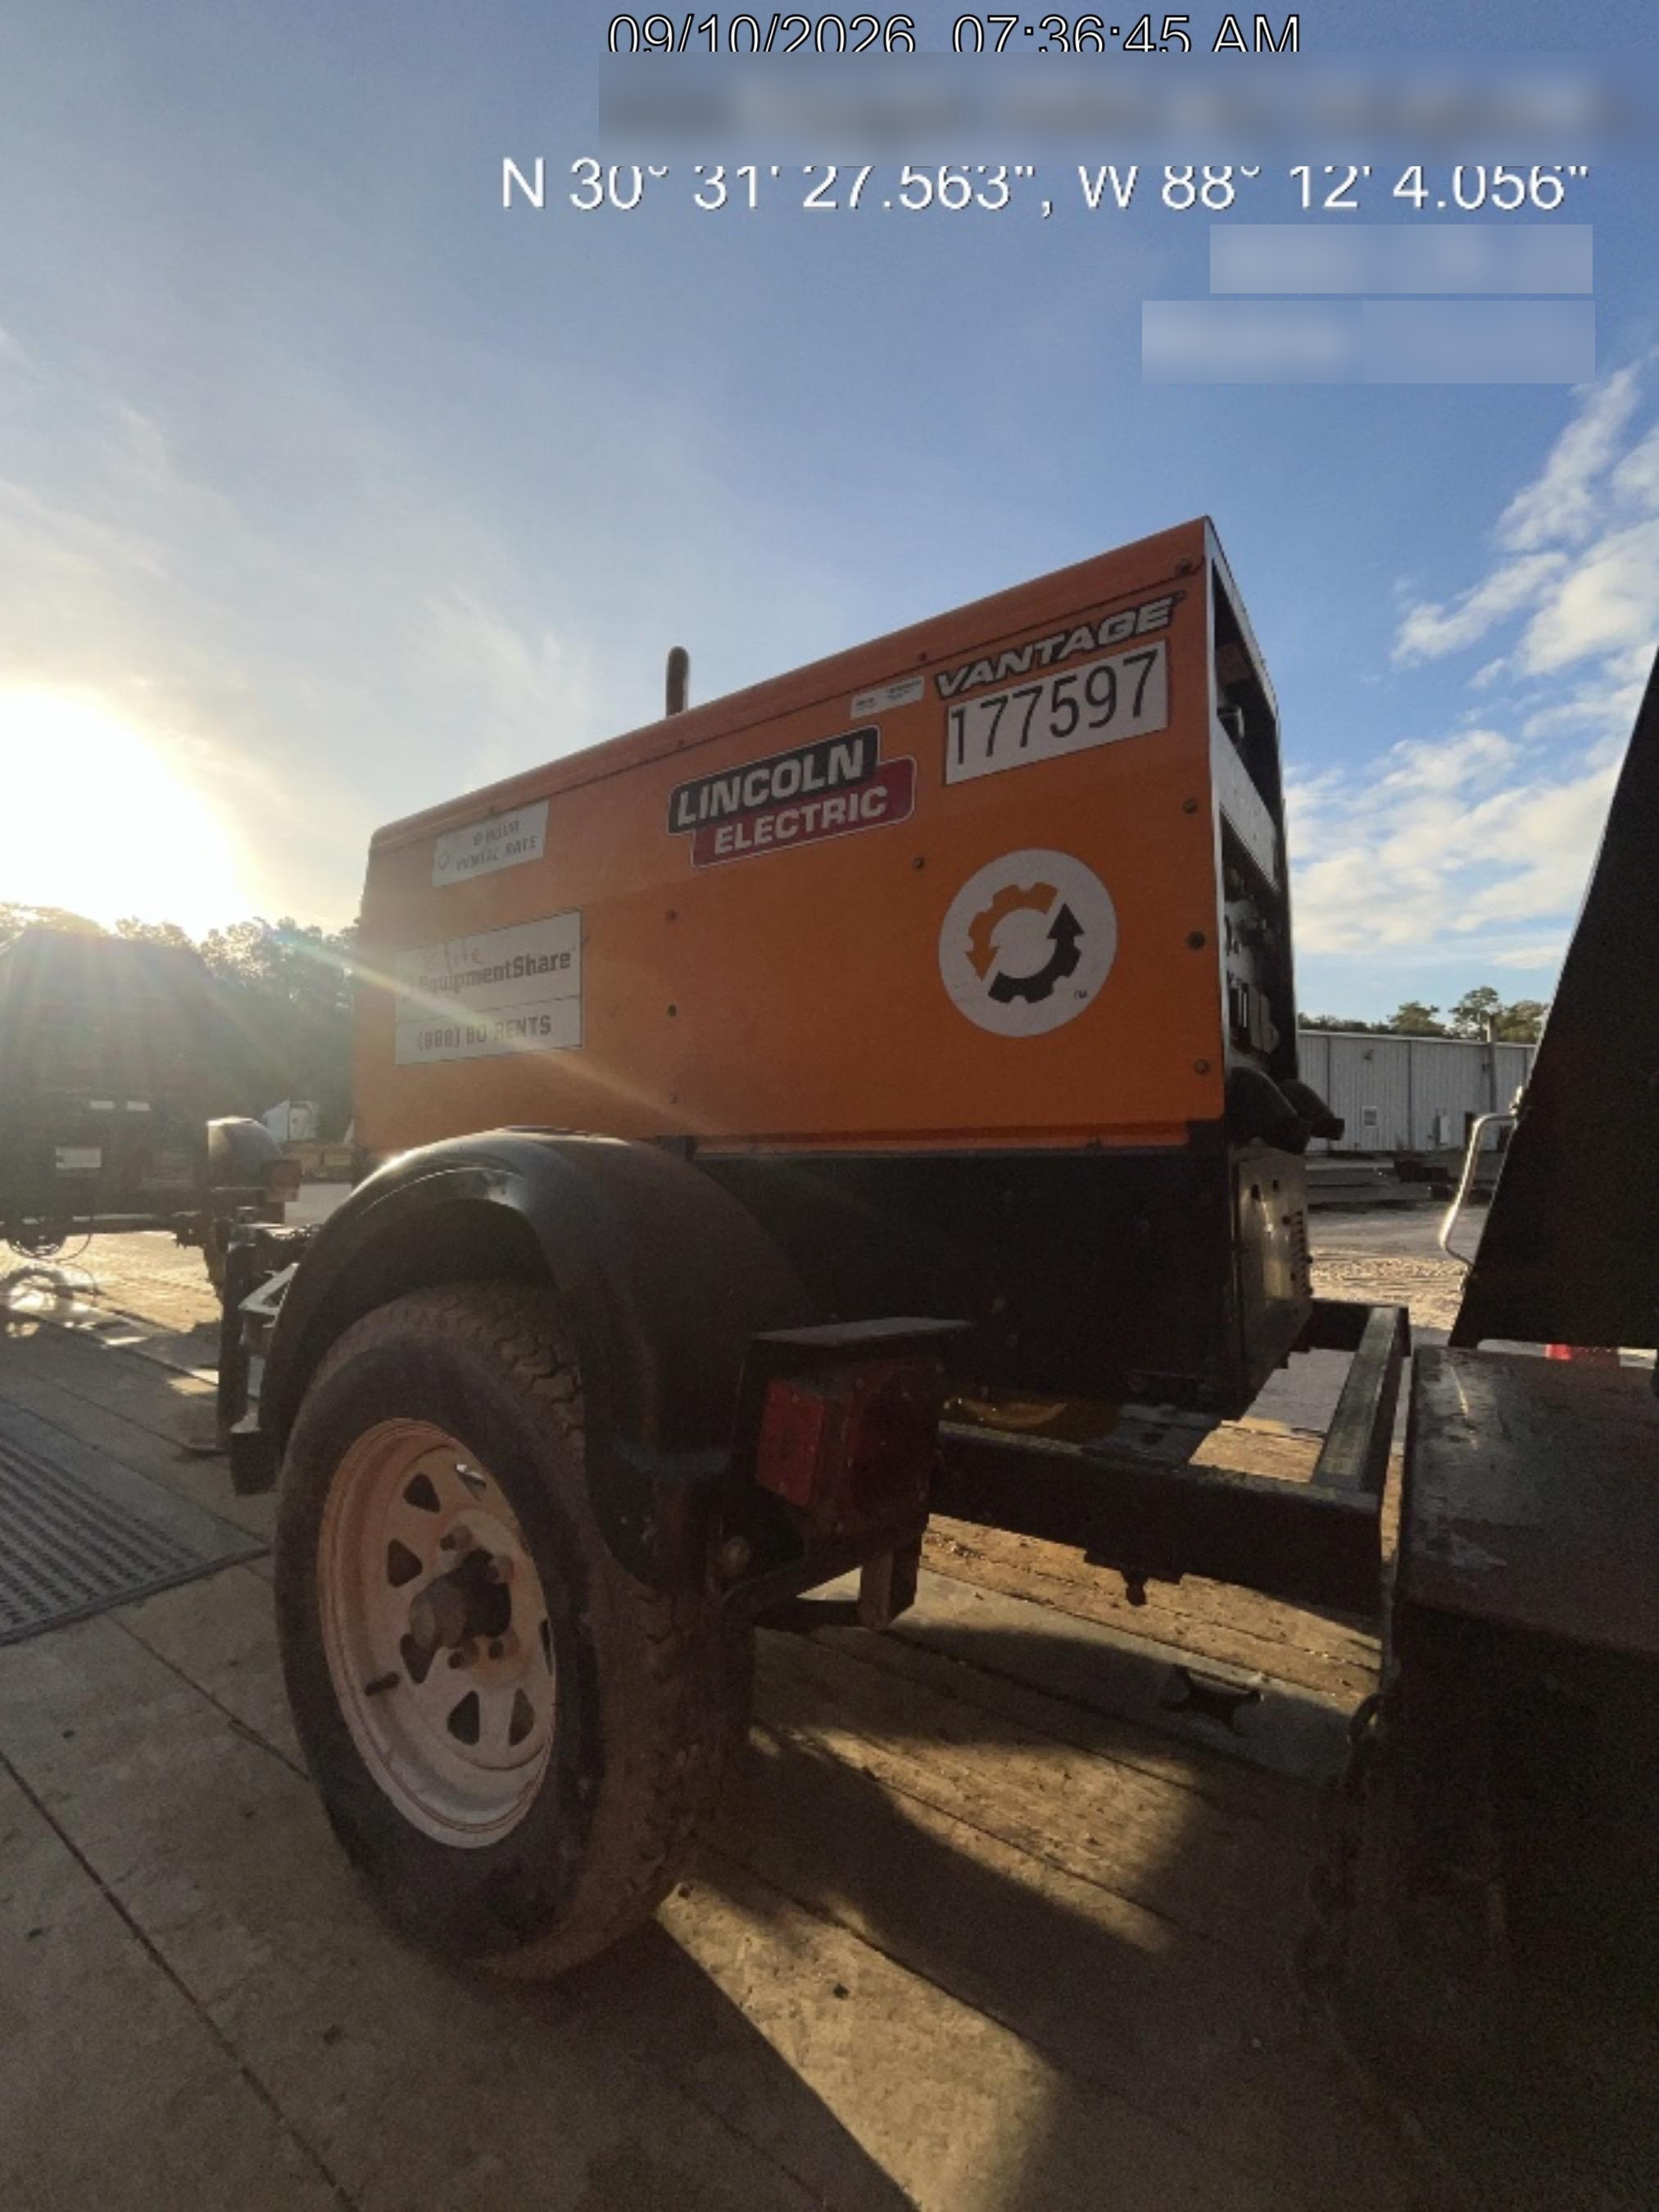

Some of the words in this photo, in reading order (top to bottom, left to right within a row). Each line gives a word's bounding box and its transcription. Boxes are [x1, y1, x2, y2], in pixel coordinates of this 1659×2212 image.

[936, 596, 1174, 699] VANTAGE
[950, 648, 1158, 765] 177597
[677, 738, 864, 827] LINCOLN
[714, 785, 888, 855] ELECTRIC
[419, 952, 571, 995] EquipmentShare
